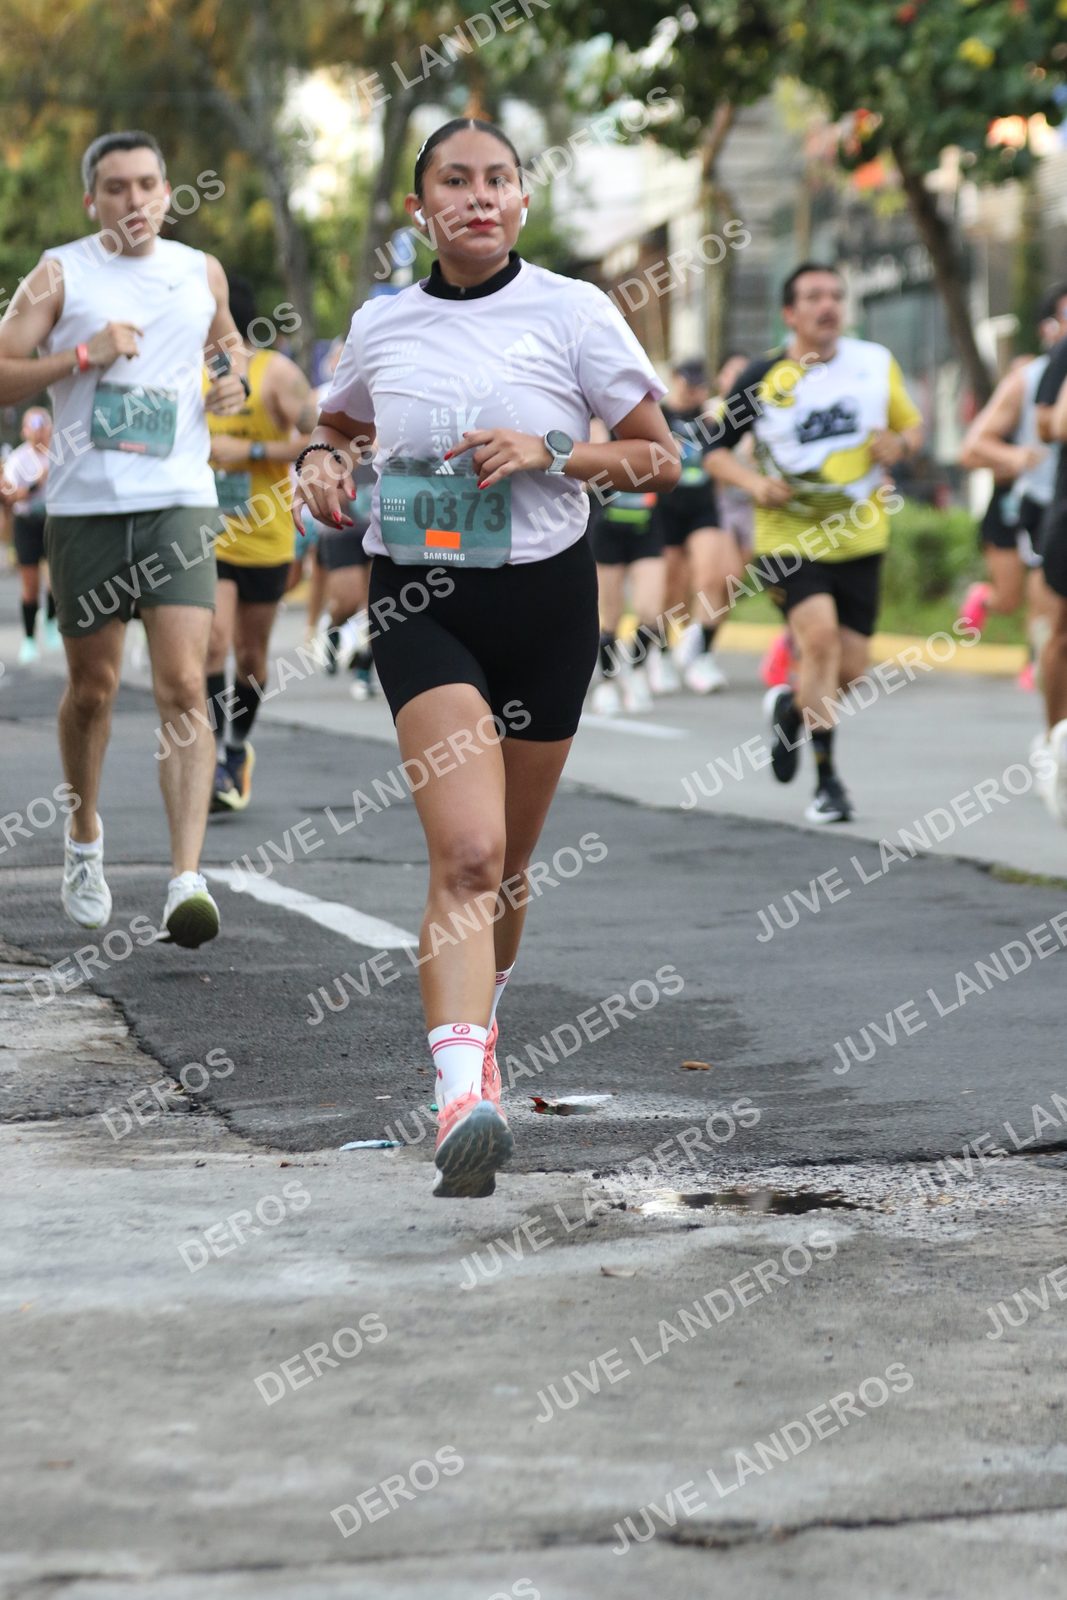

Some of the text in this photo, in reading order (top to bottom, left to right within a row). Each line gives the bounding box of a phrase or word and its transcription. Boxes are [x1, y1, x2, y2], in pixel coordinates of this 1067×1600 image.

[430, 408, 451, 427] 15
[413, 490, 506, 533] 0373
[423, 551, 466, 561] SAMSUNG
